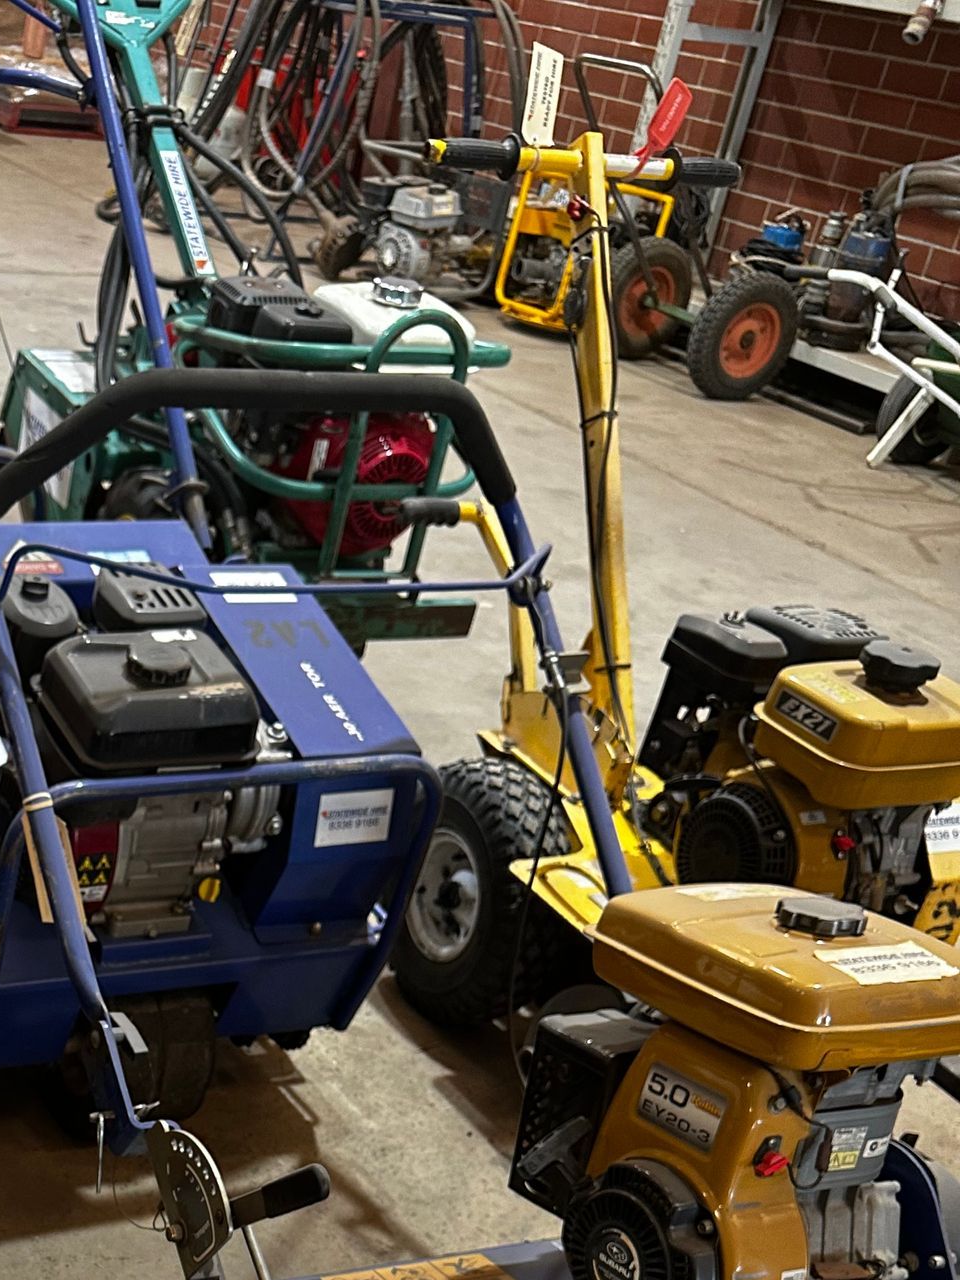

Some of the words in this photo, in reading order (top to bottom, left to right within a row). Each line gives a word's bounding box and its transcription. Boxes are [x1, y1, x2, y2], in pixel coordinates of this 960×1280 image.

[165, 156, 183, 186] HIRE
[178, 190, 206, 257] STATEWIDE
[780, 699, 828, 733] EX21
[837, 954, 901, 965] STATEWIDE
[648, 1072, 690, 1108] 5.0
[642, 1098, 710, 1143] EY20-3
[599, 1252, 630, 1278] SUBARU
